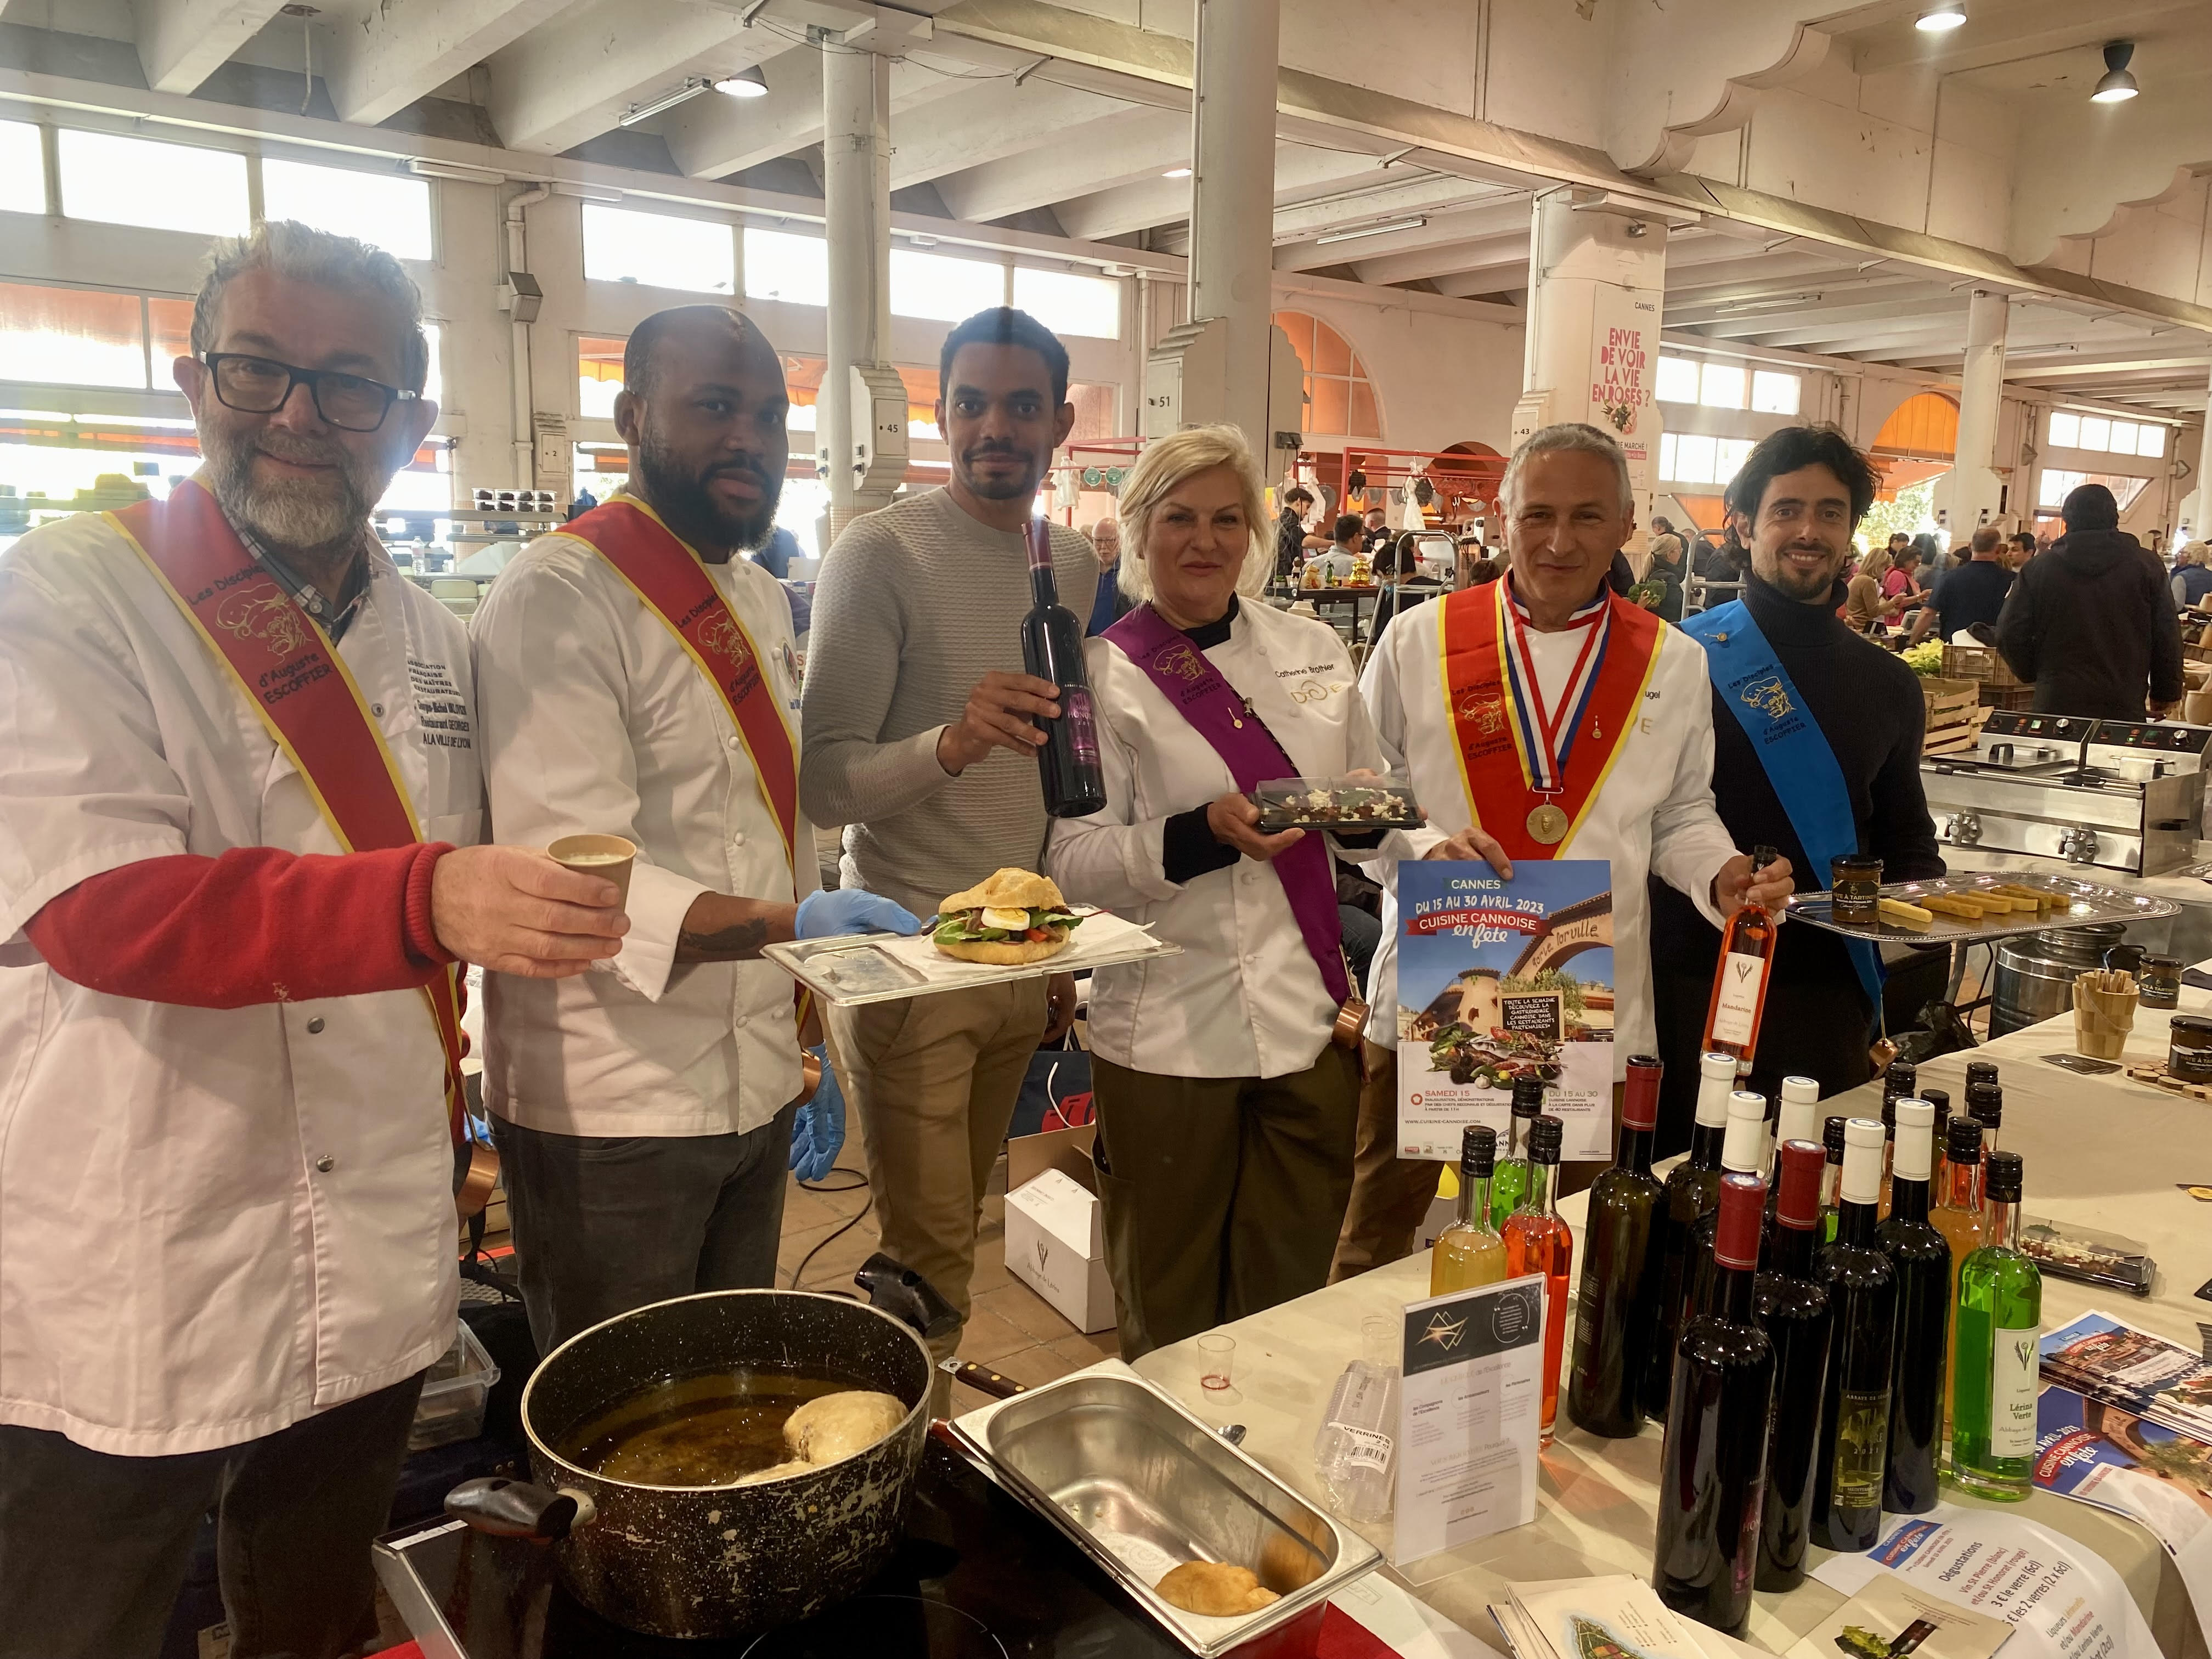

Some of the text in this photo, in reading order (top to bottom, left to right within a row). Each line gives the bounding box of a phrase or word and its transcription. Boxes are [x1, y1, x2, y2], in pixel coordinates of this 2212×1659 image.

[1635, 302, 1655, 312] CANNES
[1609, 328, 1640, 349] ENVIE
[1601, 346, 1645, 369] DE VOIR
[1605, 366, 1640, 387] LA VIE
[1159, 396, 1170, 407] 51
[1592, 383, 1605, 402] EN
[1609, 386, 1641, 406] ROSES
[887, 424, 898, 433] 45
[1624, 441, 1645, 450] MARCHÉ
[187, 588, 213, 605] Les
[675, 617, 691, 628] Les
[259, 653, 319, 687] d'Auguste
[408, 660, 445, 670] ASSOCIATION
[409, 668, 443, 678] FRANÇAISE
[1275, 669, 1307, 678] Catherine
[263, 663, 331, 704] ESCOFFIER
[1728, 664, 1774, 689] Les Disciples
[1183, 682, 1221, 705] ESCOFFIER
[1468, 680, 1500, 692] Disciples
[448, 719, 470, 731] GEORGES
[1764, 722, 1807, 745] ESCOFFIER
[457, 737, 471, 749] LYON
[1468, 743, 1513, 760] ESCOFFIER
[1451, 879, 1501, 890] CANNES
[1415, 895, 1544, 915] DU 15 AU 30 AVRIL 2023
[1419, 912, 1537, 931] CUISINE CANNOISE
[1452, 923, 1508, 949] en fête
[1722, 1002, 1751, 1014] Mandarine
[2010, 1403, 2033, 1411] Lérina
[1344, 1426, 1390, 1444] VERRINES
[2042, 1432, 2063, 1447] AVRIL
[2039, 1433, 2097, 1477] CUISINE CANNOISE
[1939, 1542, 1983, 1582] Dégustations
[1959, 1583, 1972, 1594] Vin
[1973, 1562, 1993, 1580] Pierre
[1987, 1547, 2010, 1565] (blanc)
[2053, 1560, 2073, 1576] 6cl)
[1971, 1548, 2030, 1605] et/ou St Honorat (rouge)
[2002, 1588, 2015, 1597] le
[2009, 1573, 2030, 1591] verre
[2022, 1560, 2045, 1577] (6cl)
[2042, 1576, 2057, 1587] (2
[2027, 1583, 2050, 1604] verres
[2010, 1605, 2028, 1618] les
[2020, 1600, 2033, 1609] 2
[2007, 1614, 2019, 1622] €
[2045, 1616, 2068, 1638] Liqueurs
[2060, 1610, 2095, 1650] et/ou Mandarine
[2090, 1623, 2104, 1639] Verte
[2099, 1634, 2115, 1658] (2cl)
